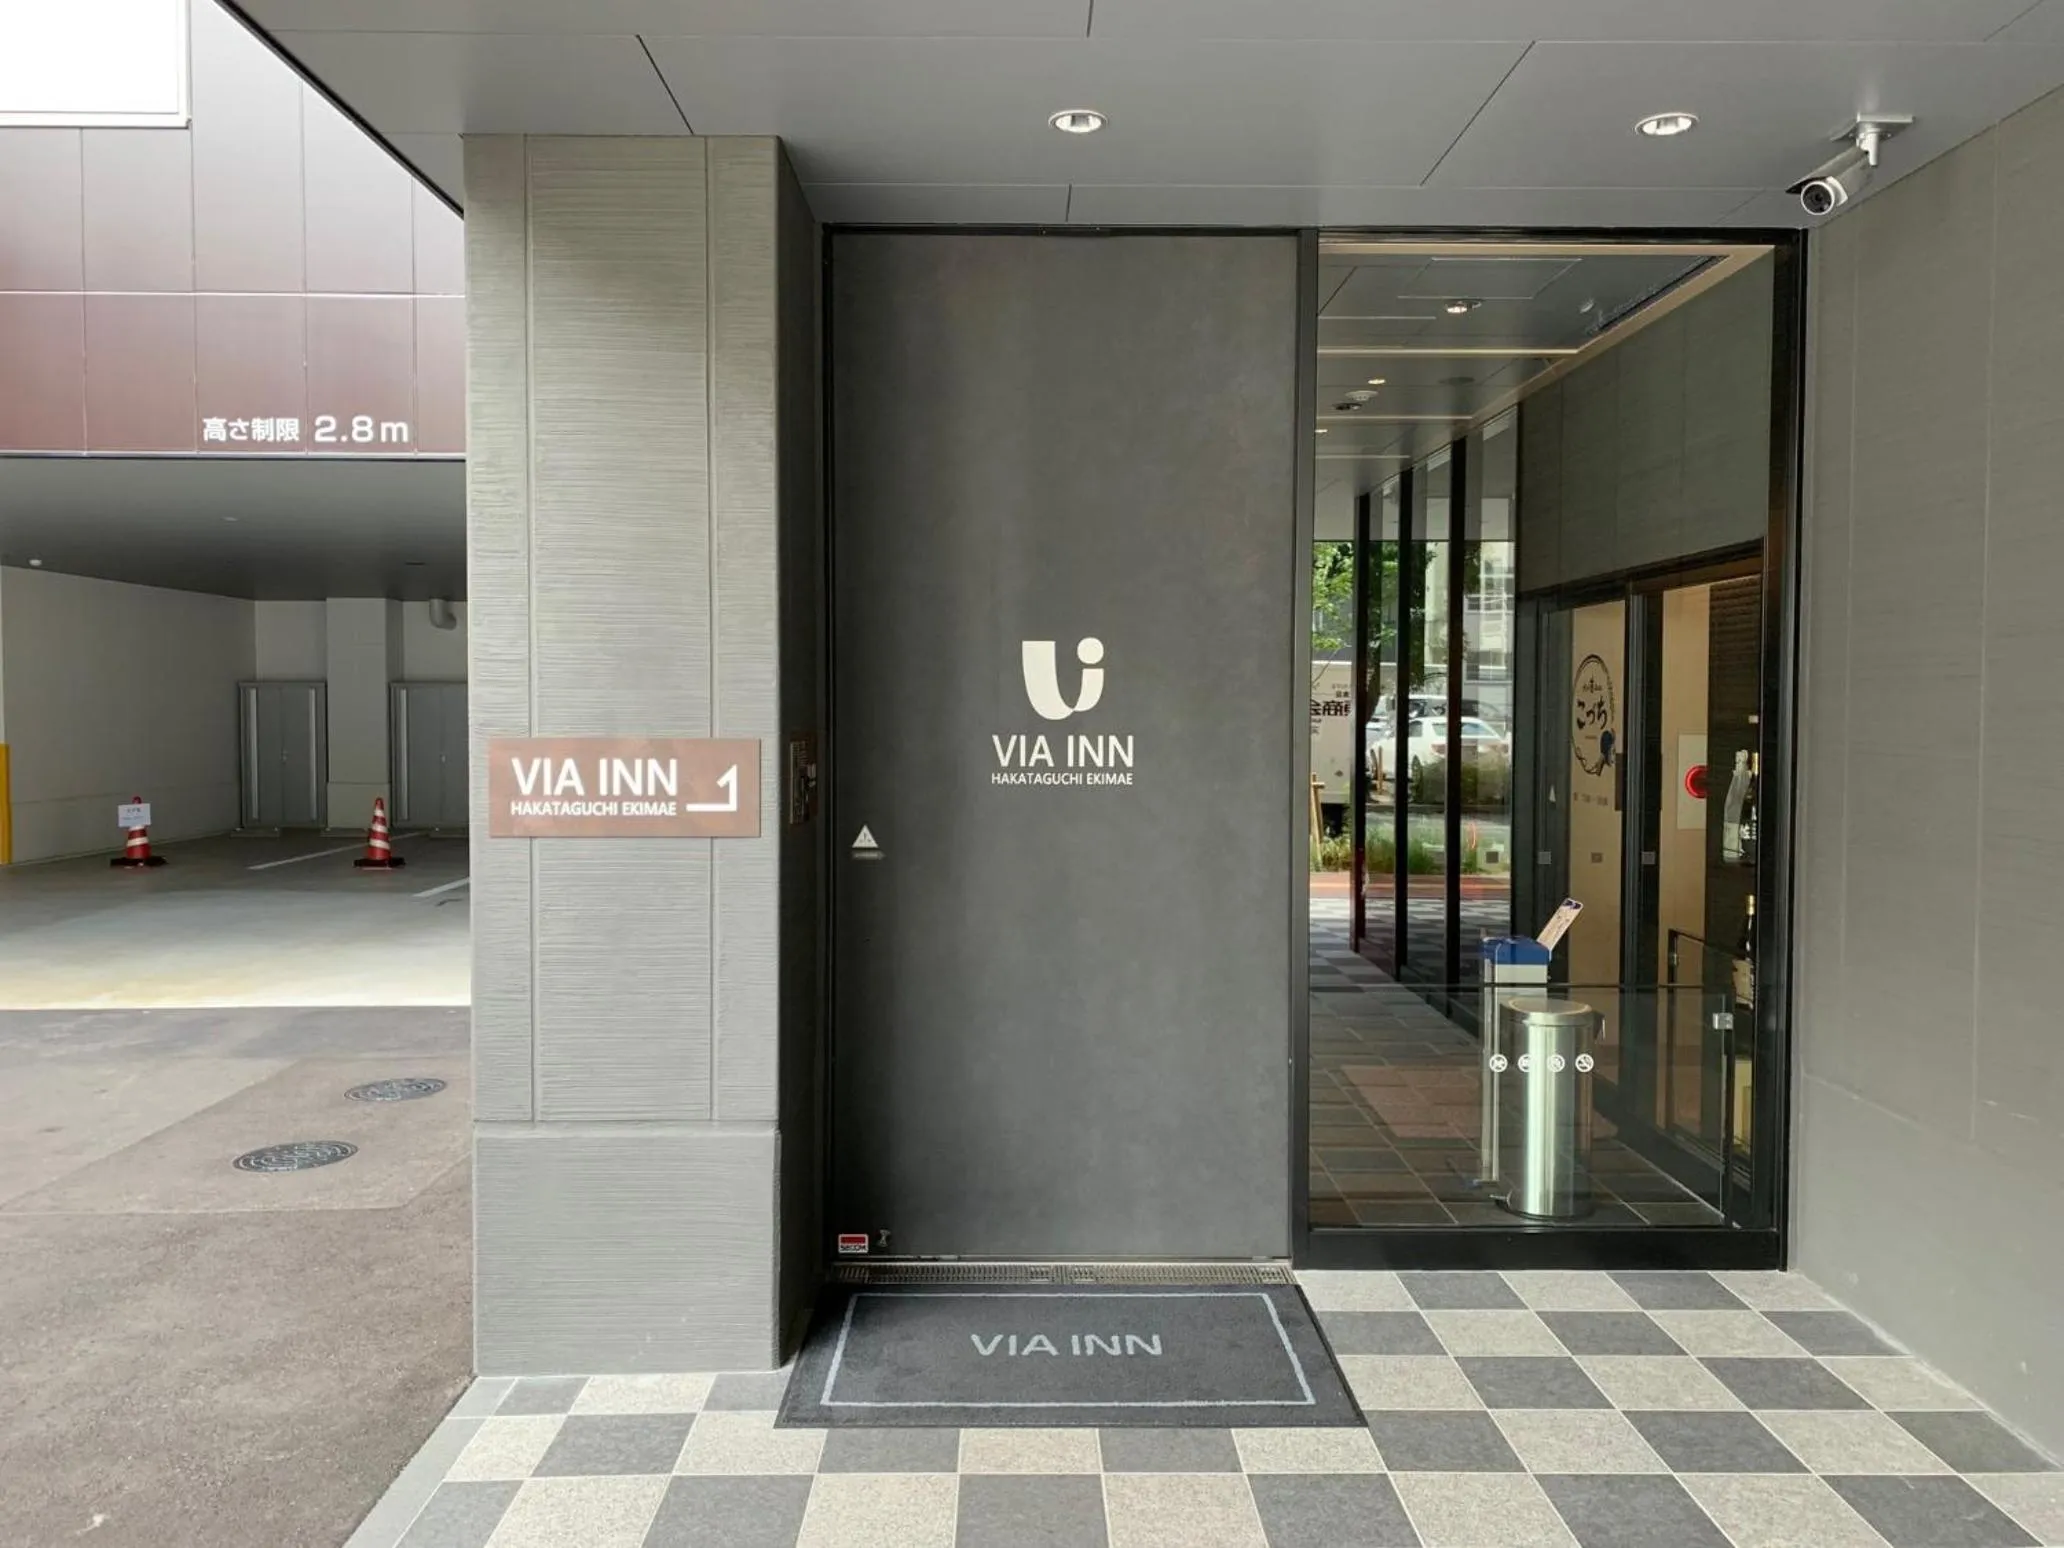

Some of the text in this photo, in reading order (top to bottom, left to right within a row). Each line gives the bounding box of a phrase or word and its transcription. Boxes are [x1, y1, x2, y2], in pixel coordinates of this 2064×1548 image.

[203, 415, 409, 443] 高さ制限 2.8m
[992, 734, 1134, 767] VIA INN
[511, 757, 678, 796] VIA INN
[991, 772, 1133, 785] HAKATAGUCHI EKIMAE
[511, 801, 677, 816] HAKATAGUCHI EKIMAE
[970, 1334, 1163, 1357] VIA INN
